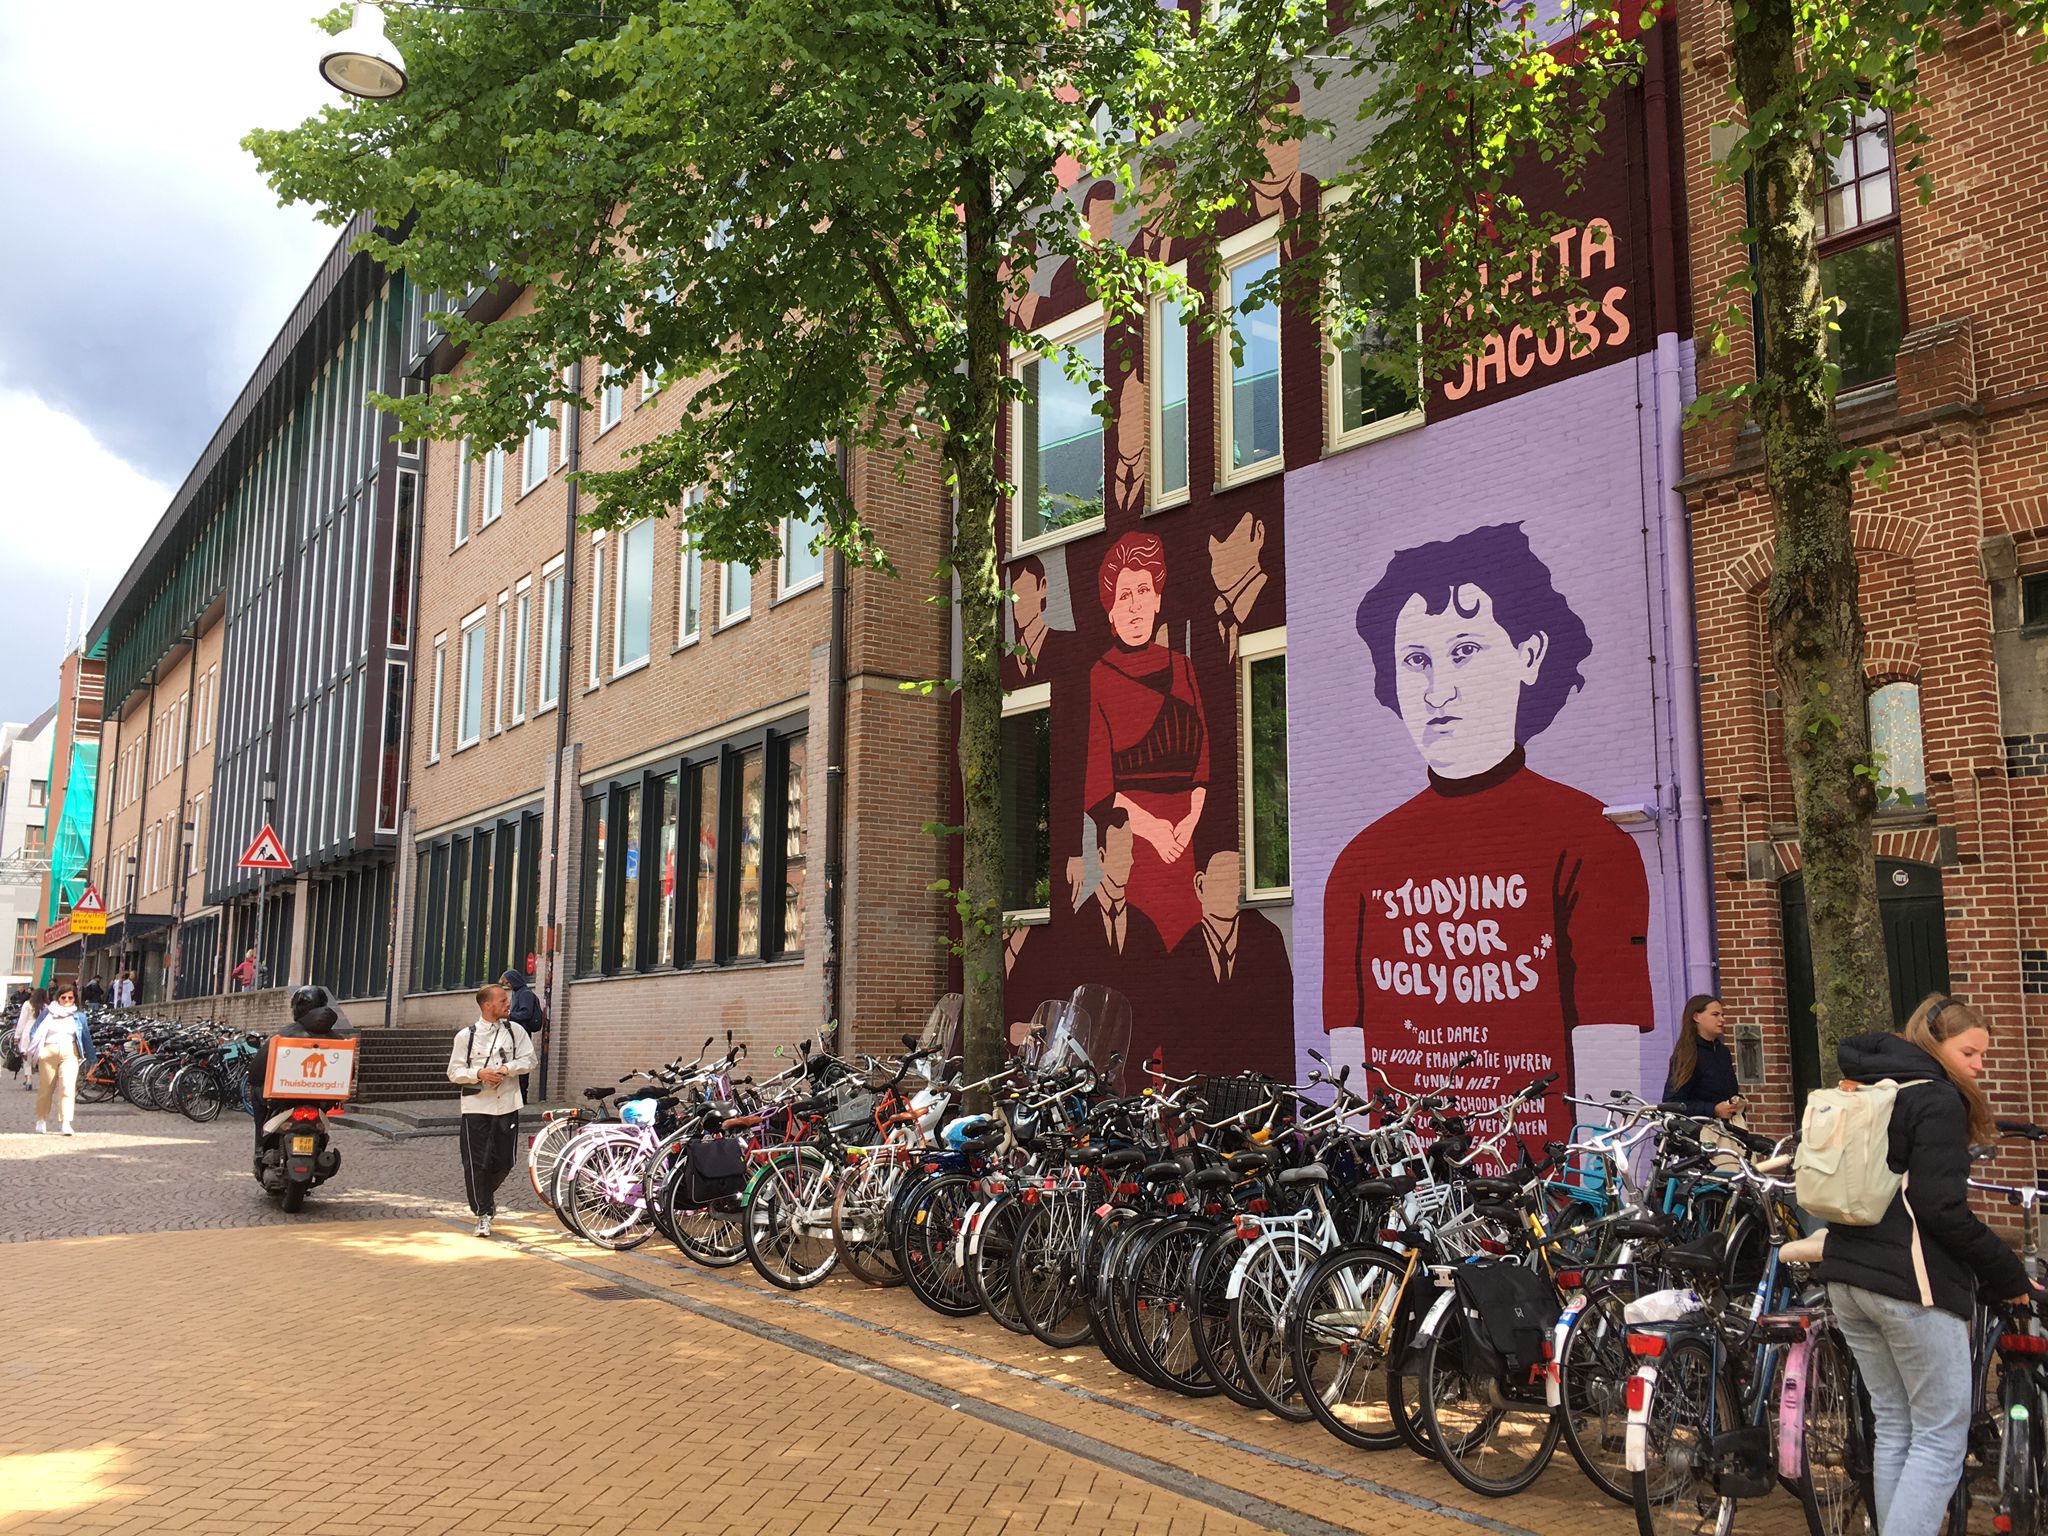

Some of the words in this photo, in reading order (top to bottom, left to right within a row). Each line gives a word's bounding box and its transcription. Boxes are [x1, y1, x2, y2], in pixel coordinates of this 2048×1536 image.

[1443, 286, 1631, 400] JACOBS
[1403, 921, 1433, 957] IS
[1438, 919, 1507, 960] FOR
[1371, 957, 1447, 1005] UGLY
[1447, 1026, 1489, 1044] DAMES
[1371, 1047, 1388, 1065] DIE
[1389, 1049, 1424, 1066] VOOR
[1504, 1054, 1552, 1075] IJVEREN
[279, 1079, 345, 1091] Thuisbezorgd.nl
[1465, 1076, 1501, 1091] NIET
[1454, 1094, 1498, 1113] SCHOON
